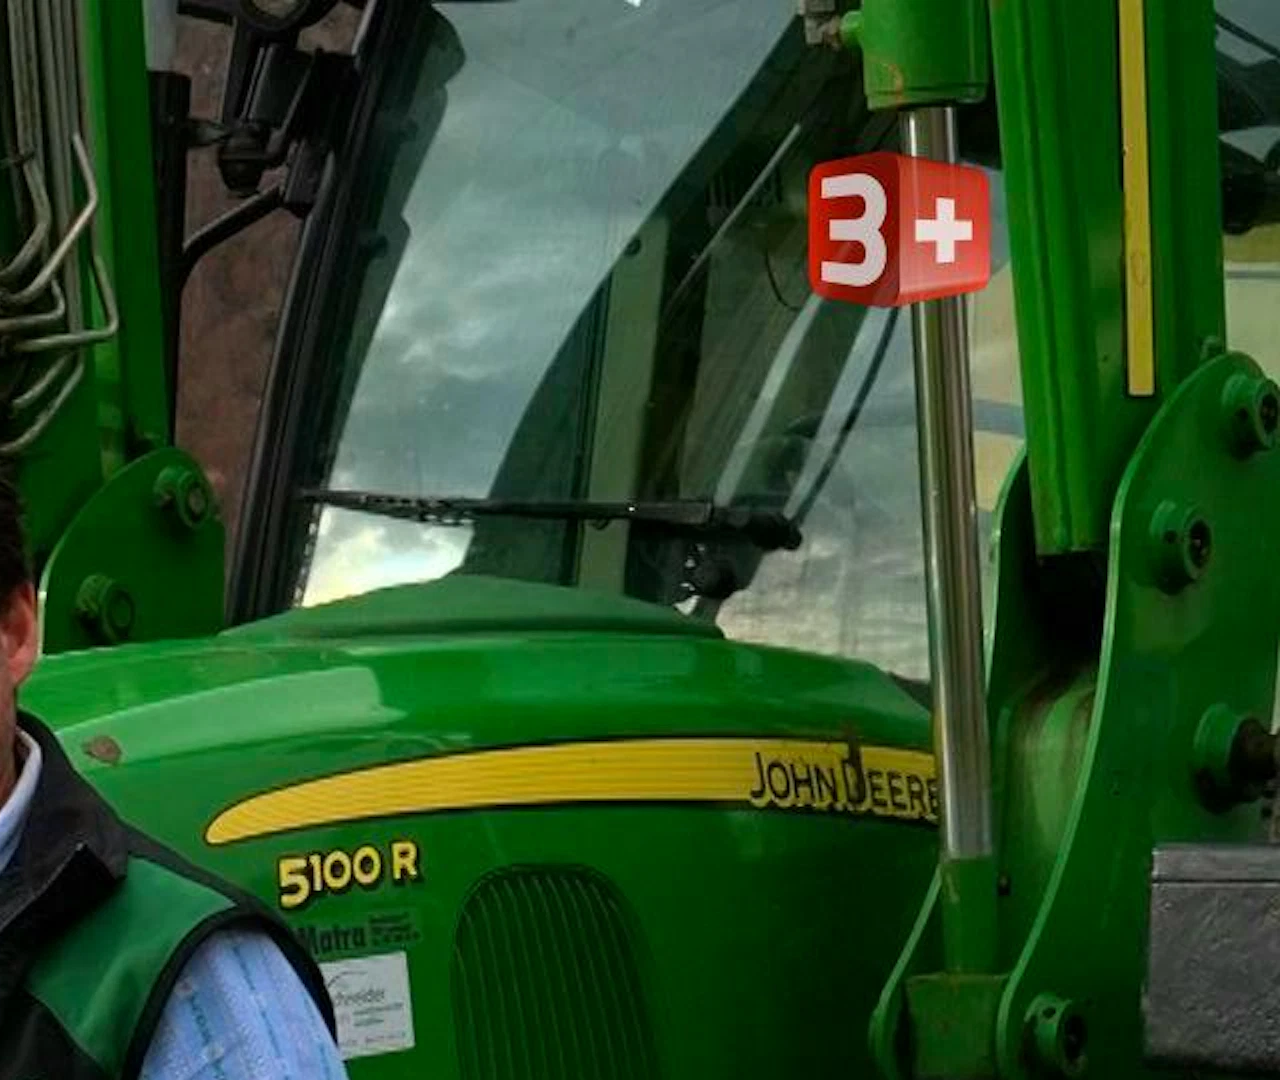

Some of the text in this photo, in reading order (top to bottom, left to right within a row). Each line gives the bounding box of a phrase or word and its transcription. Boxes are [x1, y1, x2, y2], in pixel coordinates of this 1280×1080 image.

[750, 751, 839, 801] JOHN
[277, 840, 419, 909] 5100 R
